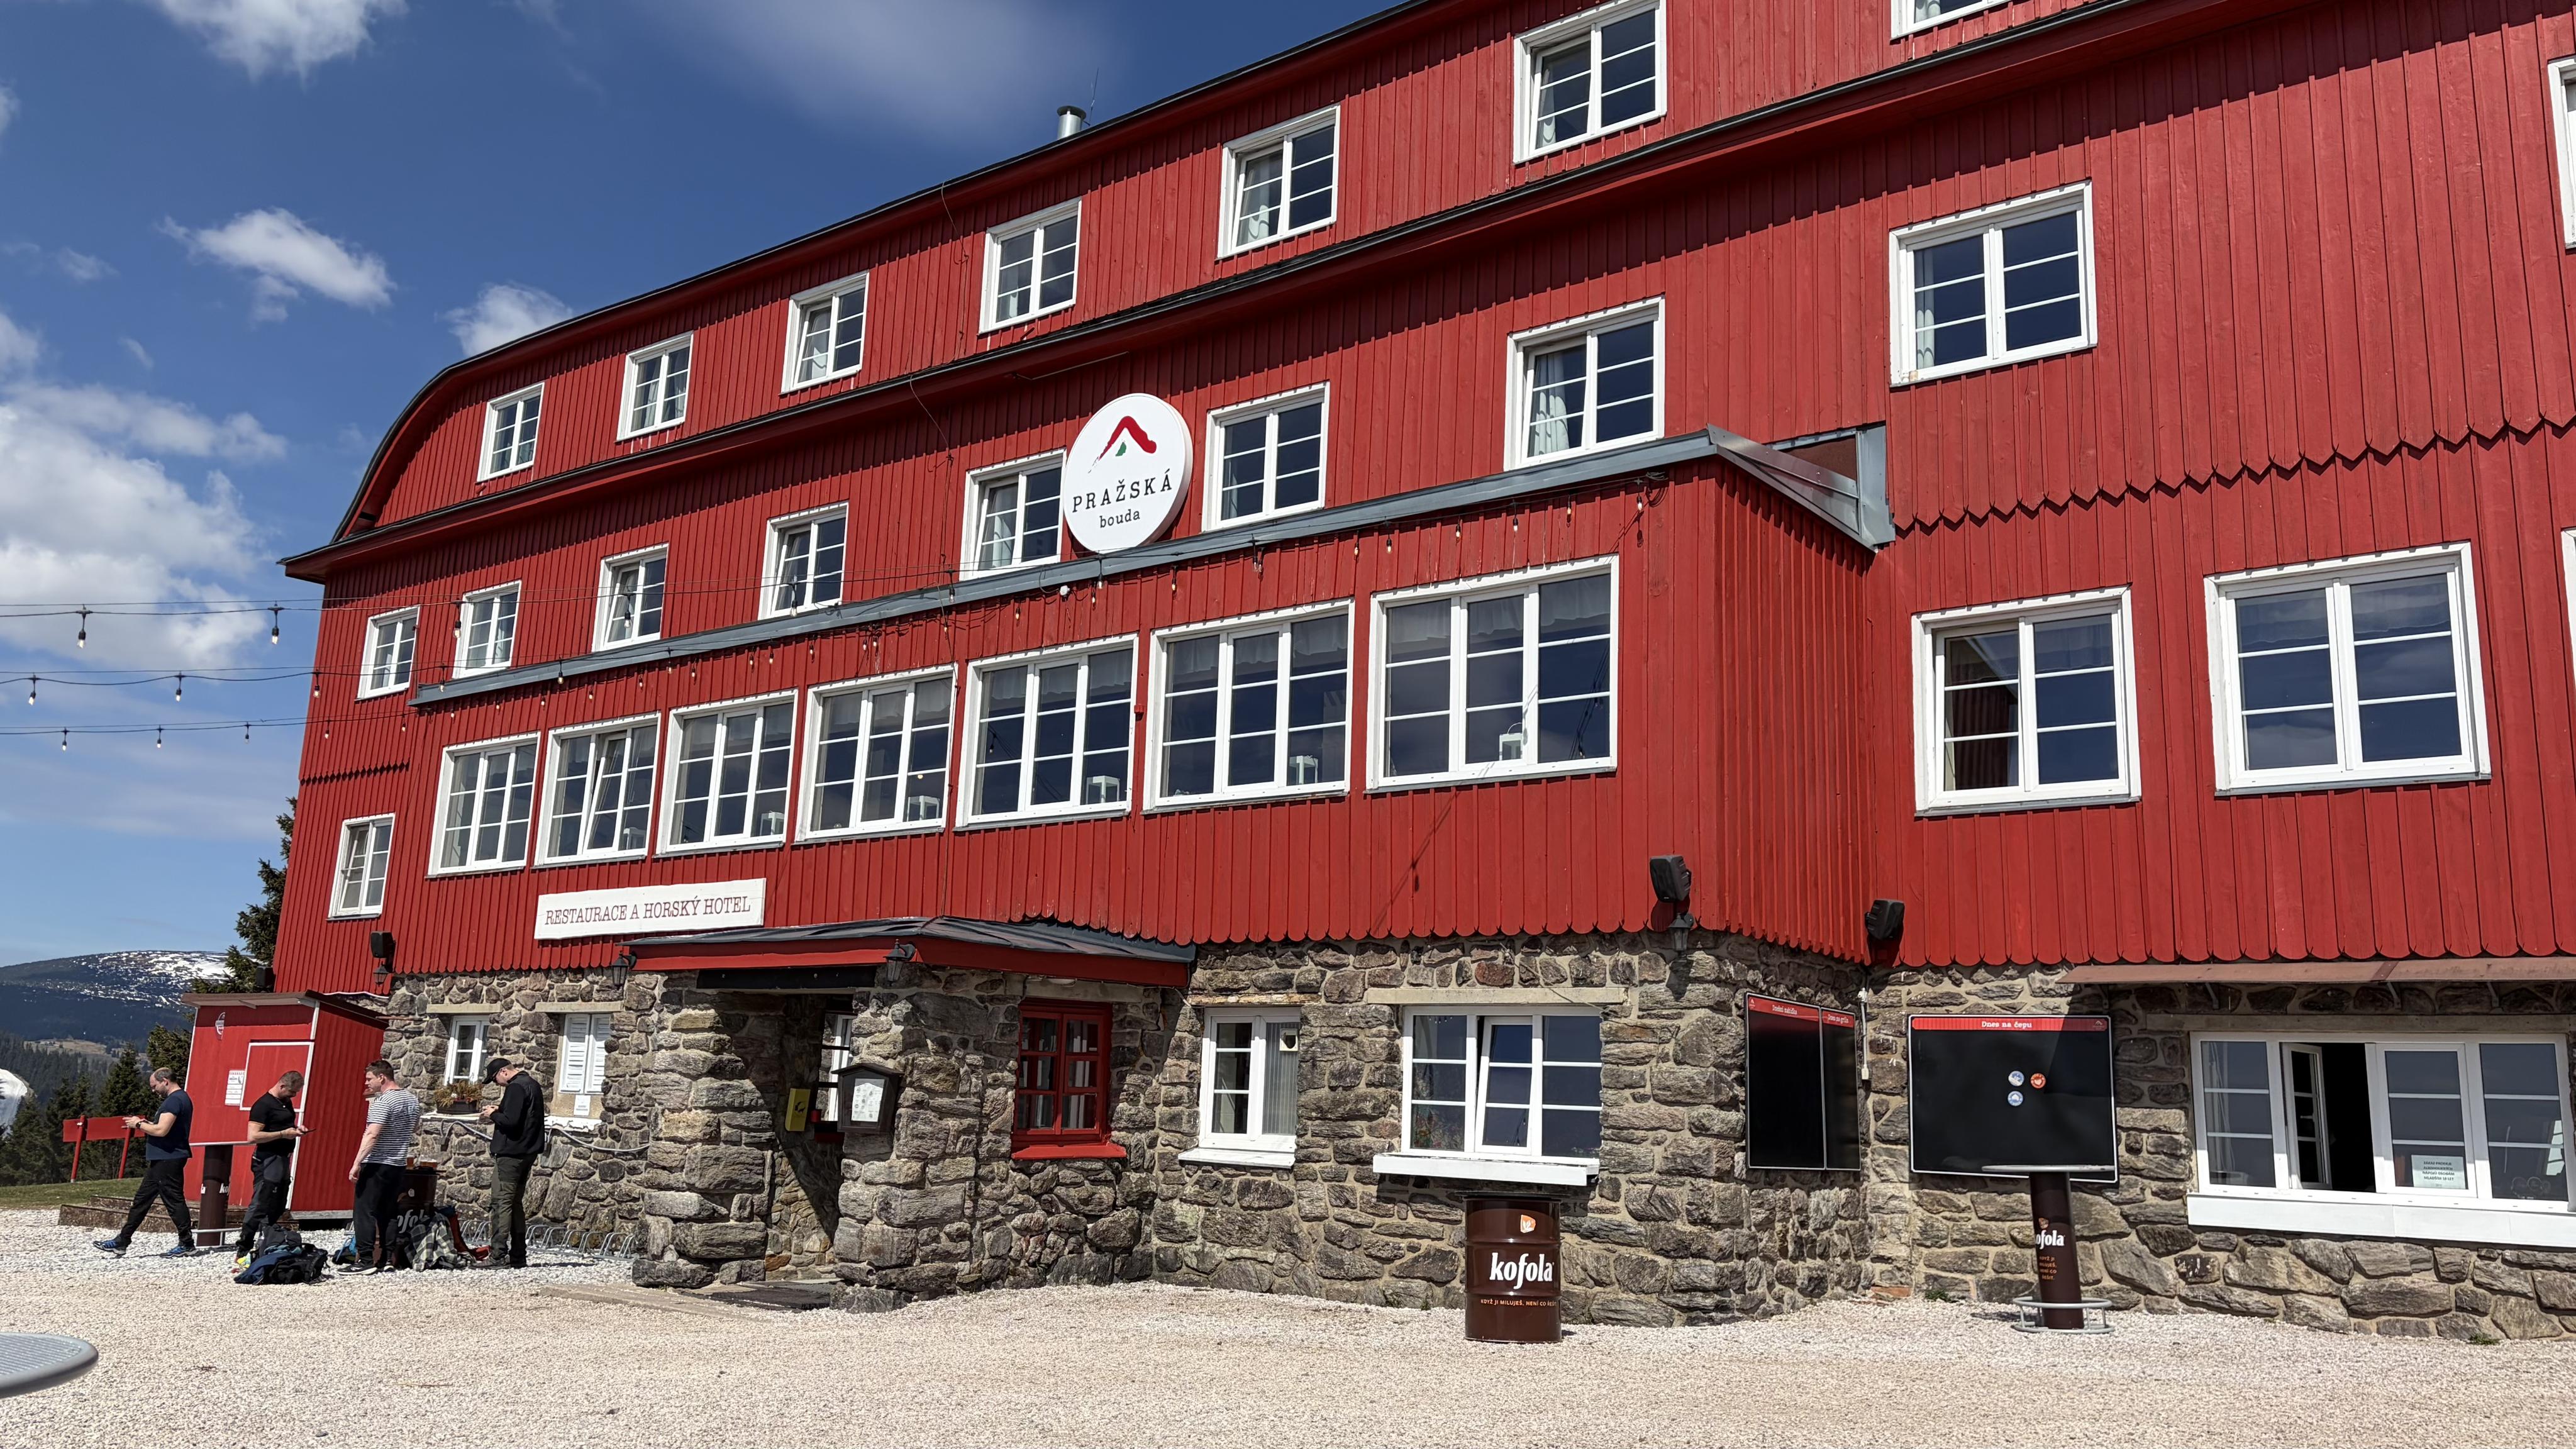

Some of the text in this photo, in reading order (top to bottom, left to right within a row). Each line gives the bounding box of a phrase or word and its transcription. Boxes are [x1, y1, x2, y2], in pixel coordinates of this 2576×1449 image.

[1072, 468, 1172, 513] PRAŽSKÁ
[1099, 509, 1140, 528] bouda
[545, 896, 751, 925] RESTAURACE A HORSKÝ HOTEL
[2014, 1021, 2033, 1029] čepu
[2036, 1230, 2065, 1250] ofola
[1489, 1252, 1553, 1290] kofola
